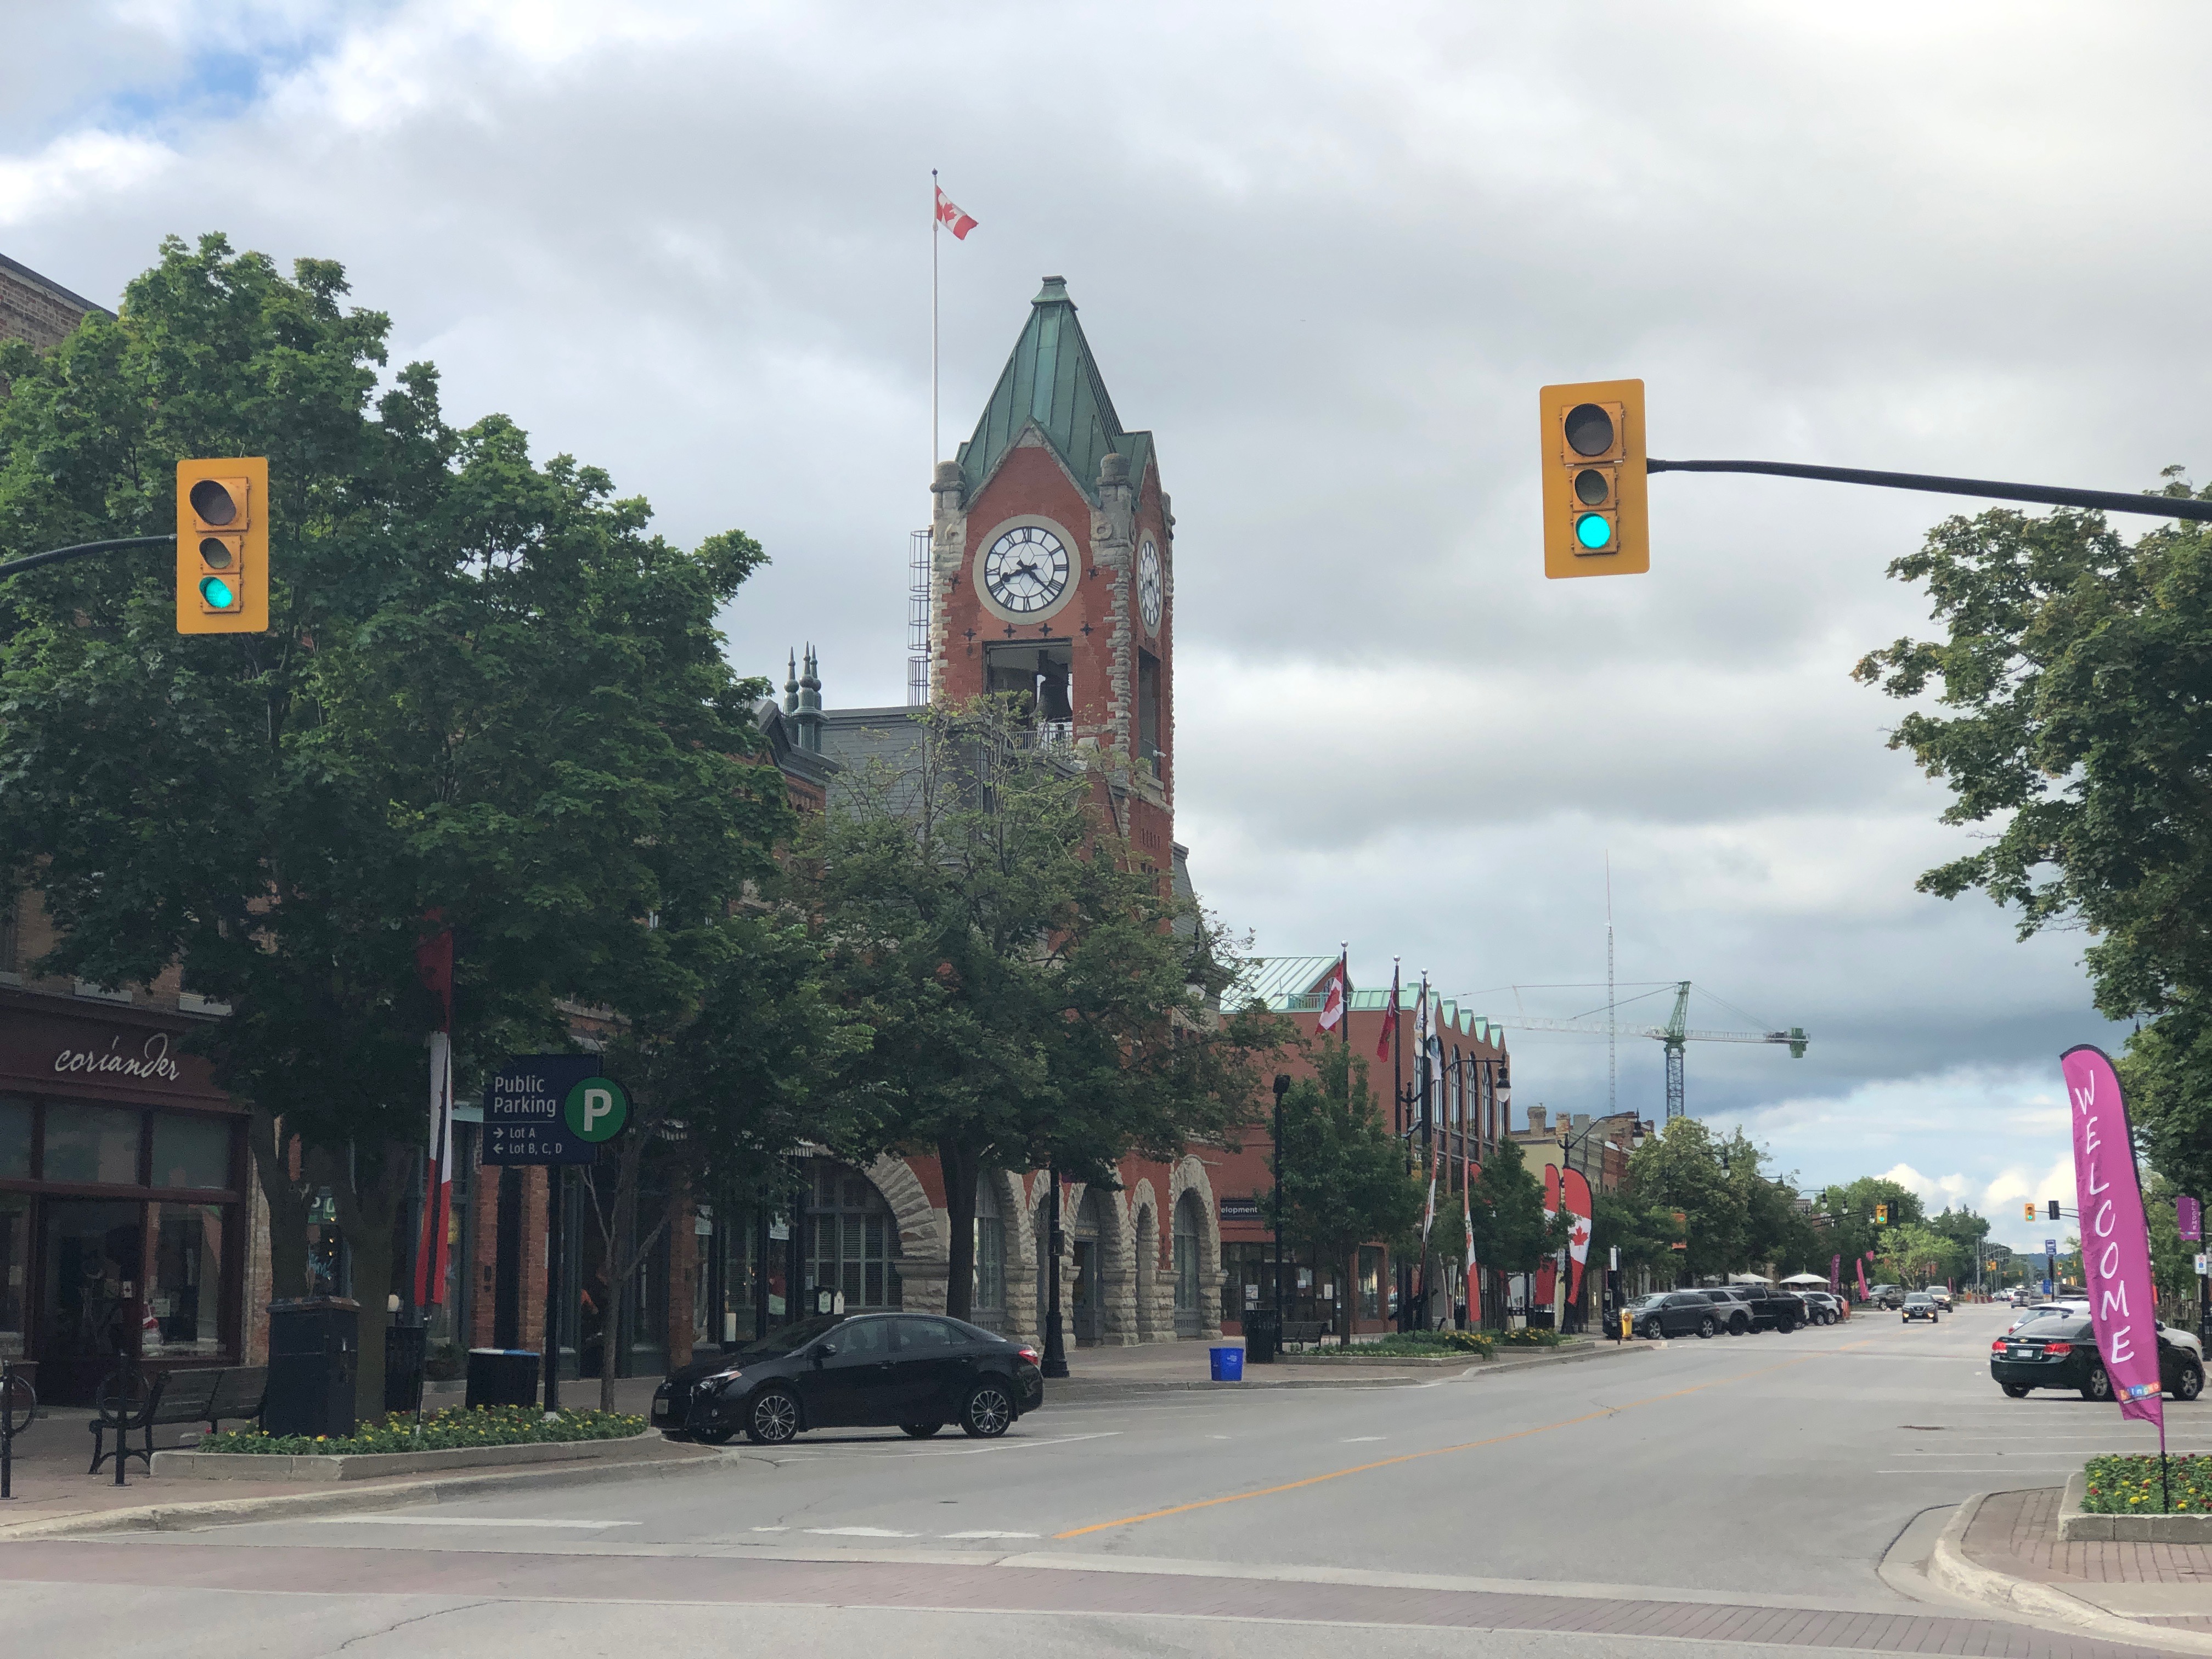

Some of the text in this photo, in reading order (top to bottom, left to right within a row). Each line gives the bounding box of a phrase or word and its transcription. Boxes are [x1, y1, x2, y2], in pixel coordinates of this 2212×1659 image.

[54, 1032, 180, 1081] coriander
[494, 1075, 545, 1093] Public
[493, 1095, 556, 1118] Parking
[584, 1088, 612, 1132] P
[510, 1127, 535, 1139] Lot A
[509, 1143, 562, 1155] Lot B, C, D
[2075, 1070, 2135, 1364] WELCOME
